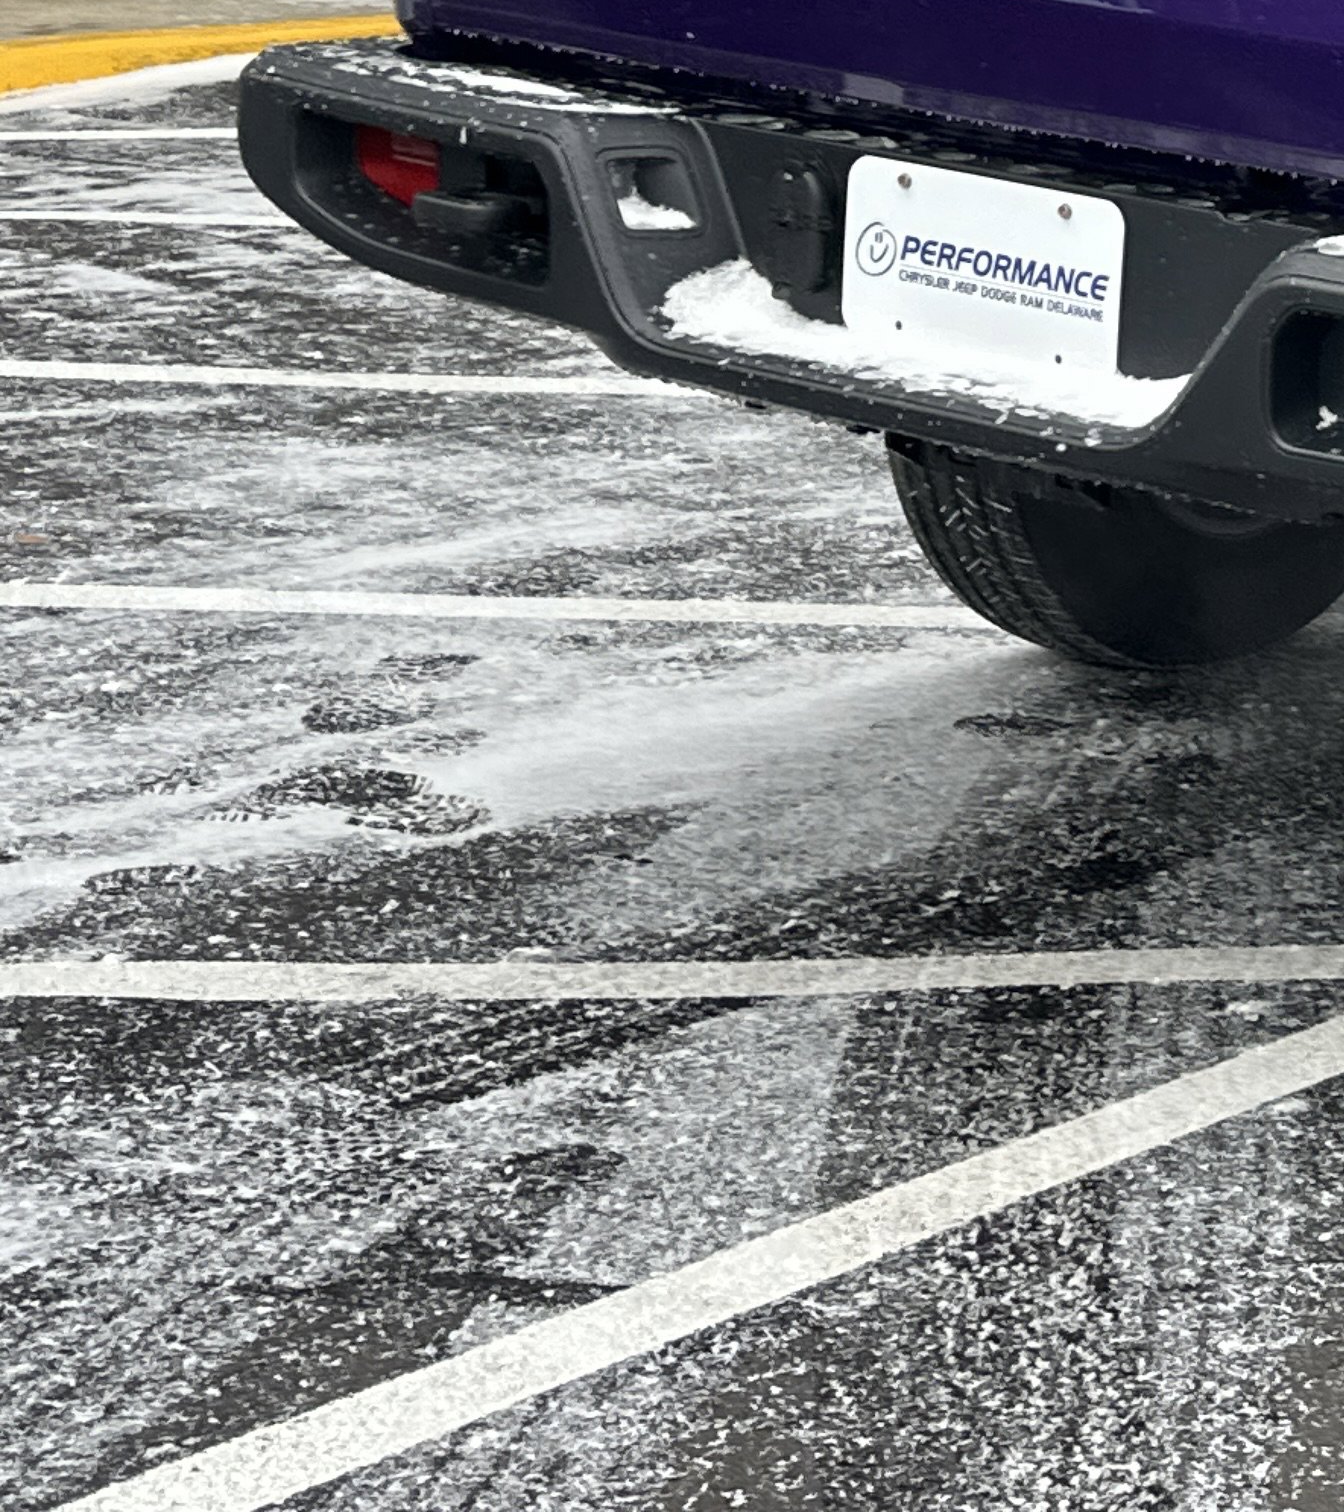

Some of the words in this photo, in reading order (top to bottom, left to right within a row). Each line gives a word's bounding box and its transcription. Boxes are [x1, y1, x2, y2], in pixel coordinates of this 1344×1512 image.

[899, 269, 949, 290] CHRYSLER
[952, 281, 978, 295] JEEP
[981, 285, 1017, 304] DODGE
[1020, 294, 1044, 309] RAM
[1046, 299, 1104, 322] DELAWARE
[900, 235, 1110, 302] PERFORMANCE
